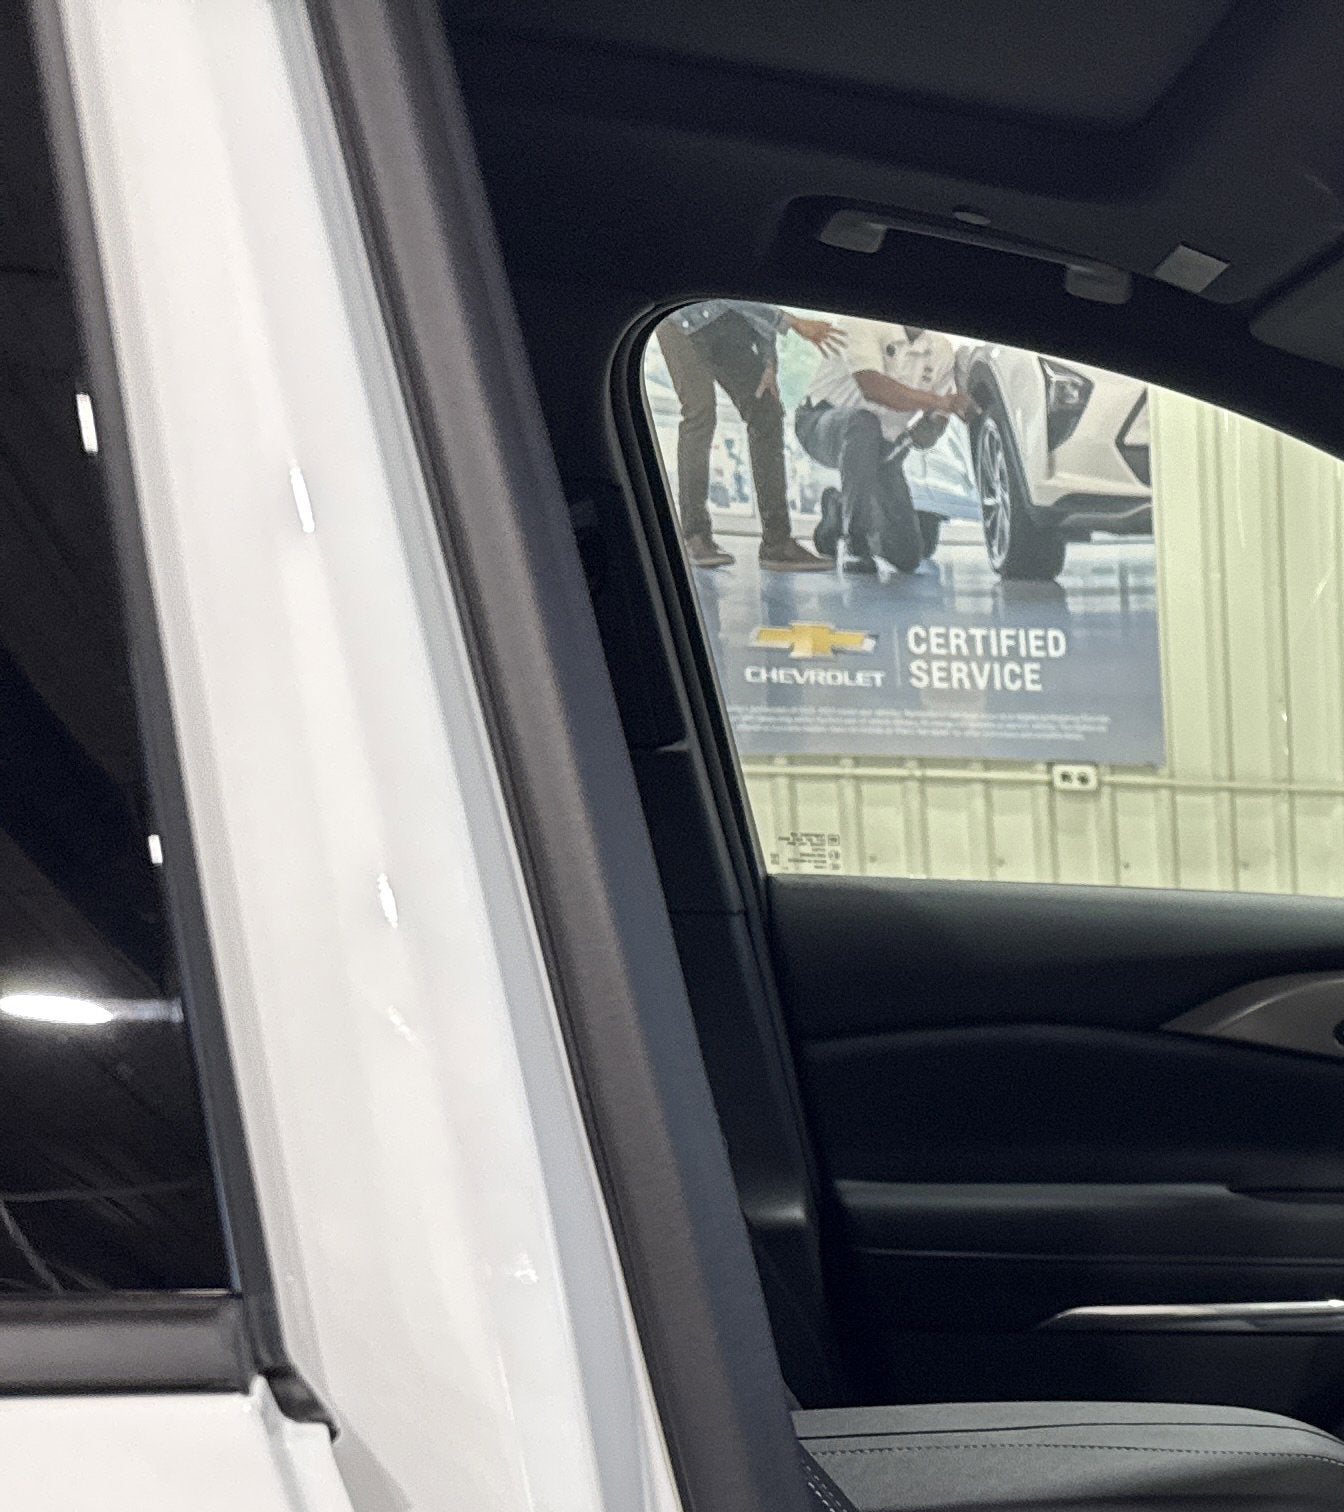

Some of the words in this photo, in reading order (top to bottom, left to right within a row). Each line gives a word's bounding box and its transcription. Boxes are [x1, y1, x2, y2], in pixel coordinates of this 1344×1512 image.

[907, 625, 1067, 658] CERTIFIED
[744, 666, 886, 687] CHEVROLET
[909, 659, 1042, 692] SERVICE
